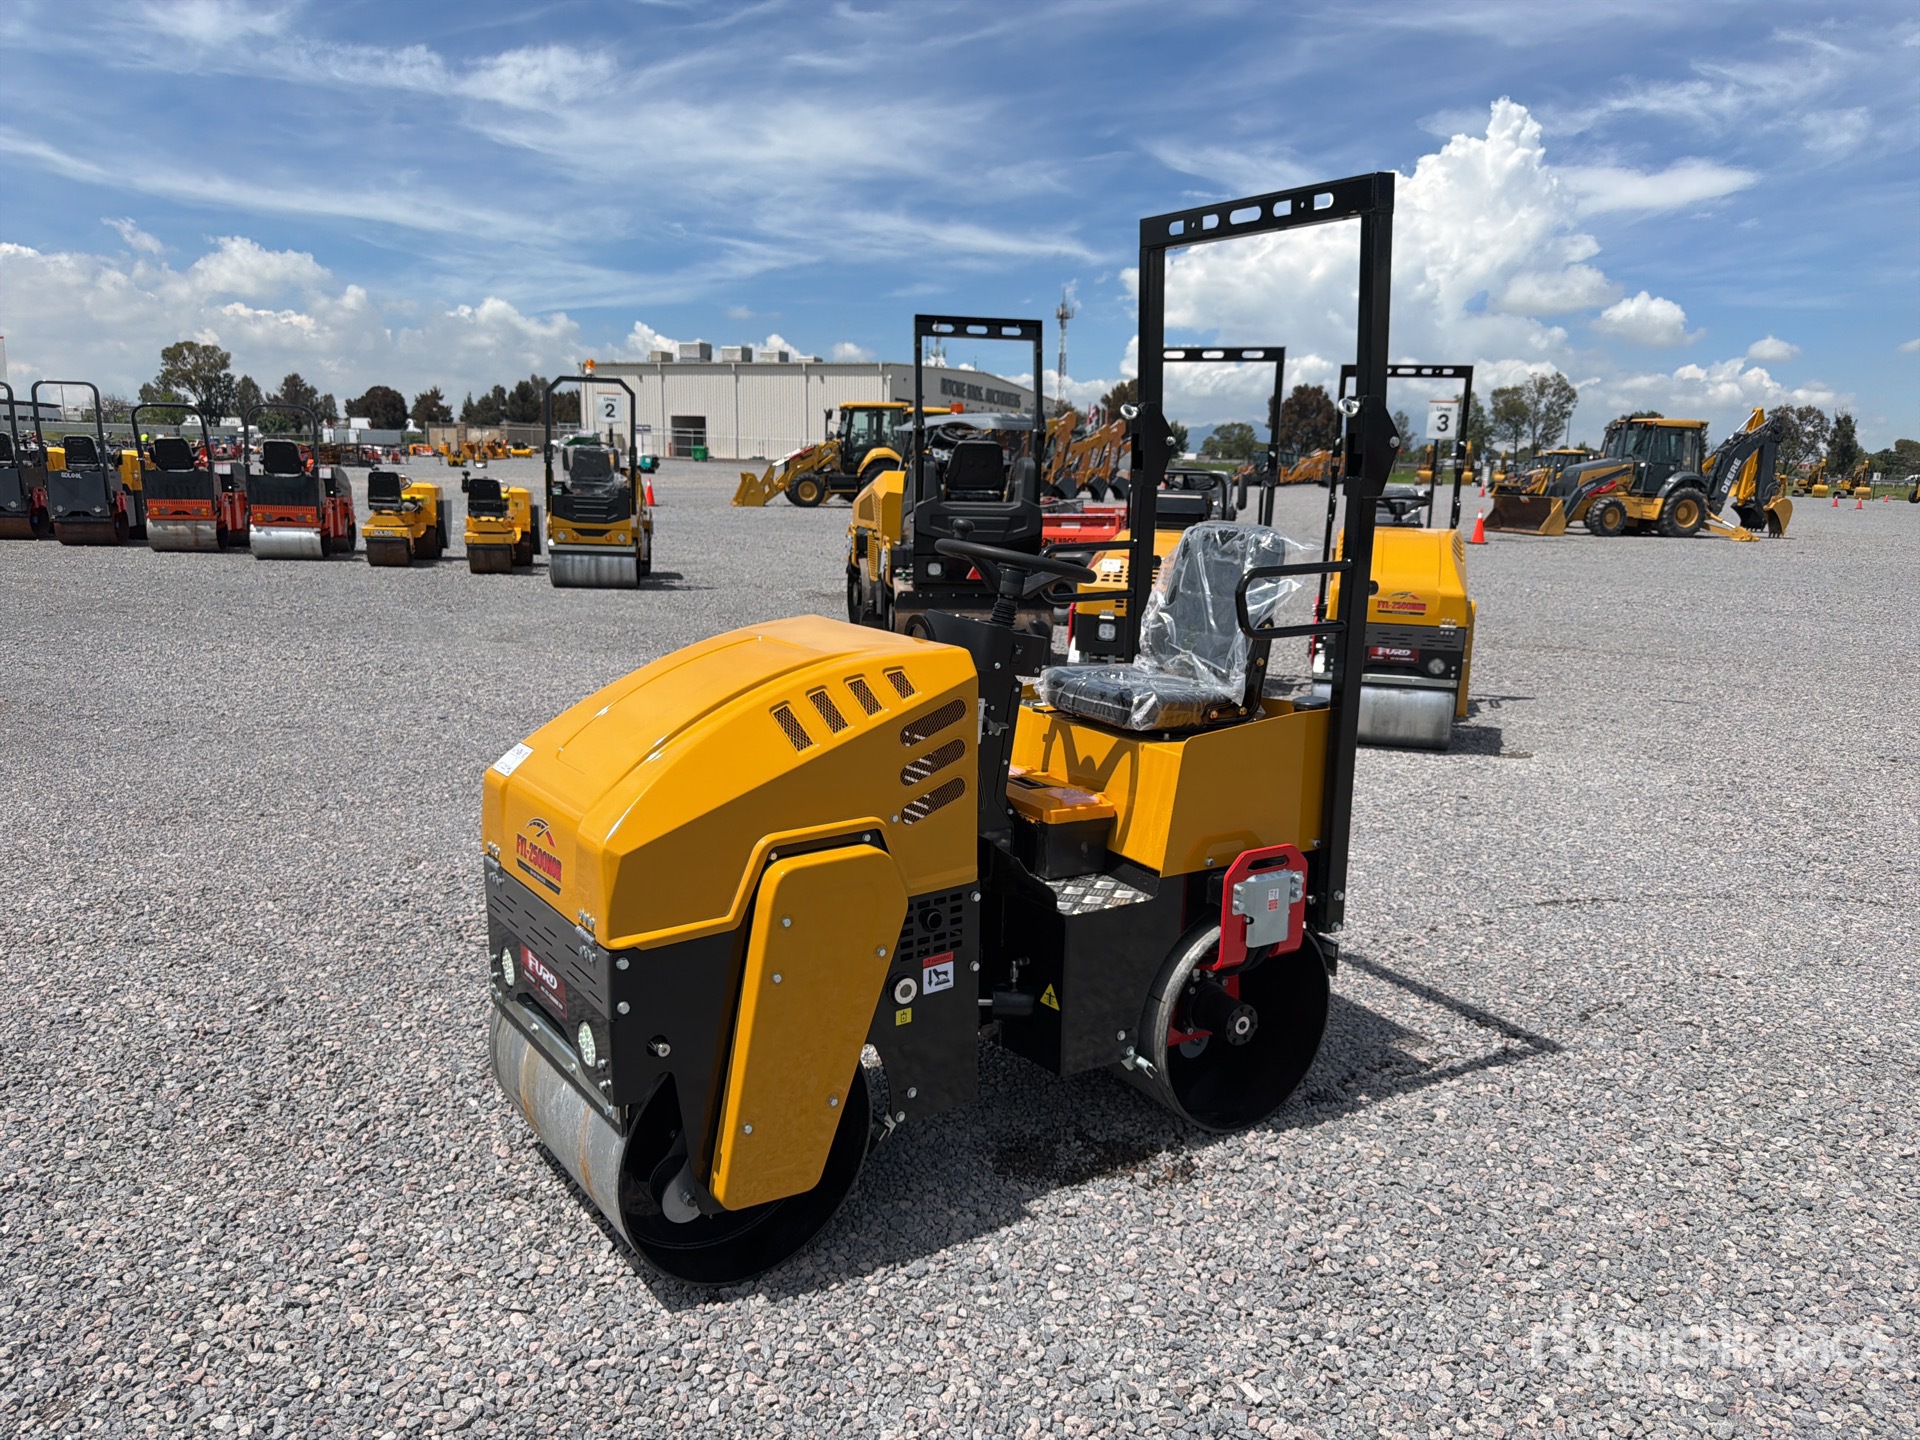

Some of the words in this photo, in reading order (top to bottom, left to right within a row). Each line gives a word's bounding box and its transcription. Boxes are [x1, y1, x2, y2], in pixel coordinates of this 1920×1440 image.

[605, 403, 616, 418] 2
[1436, 413, 1450, 432] 3
[1721, 457, 1742, 494] DEERE
